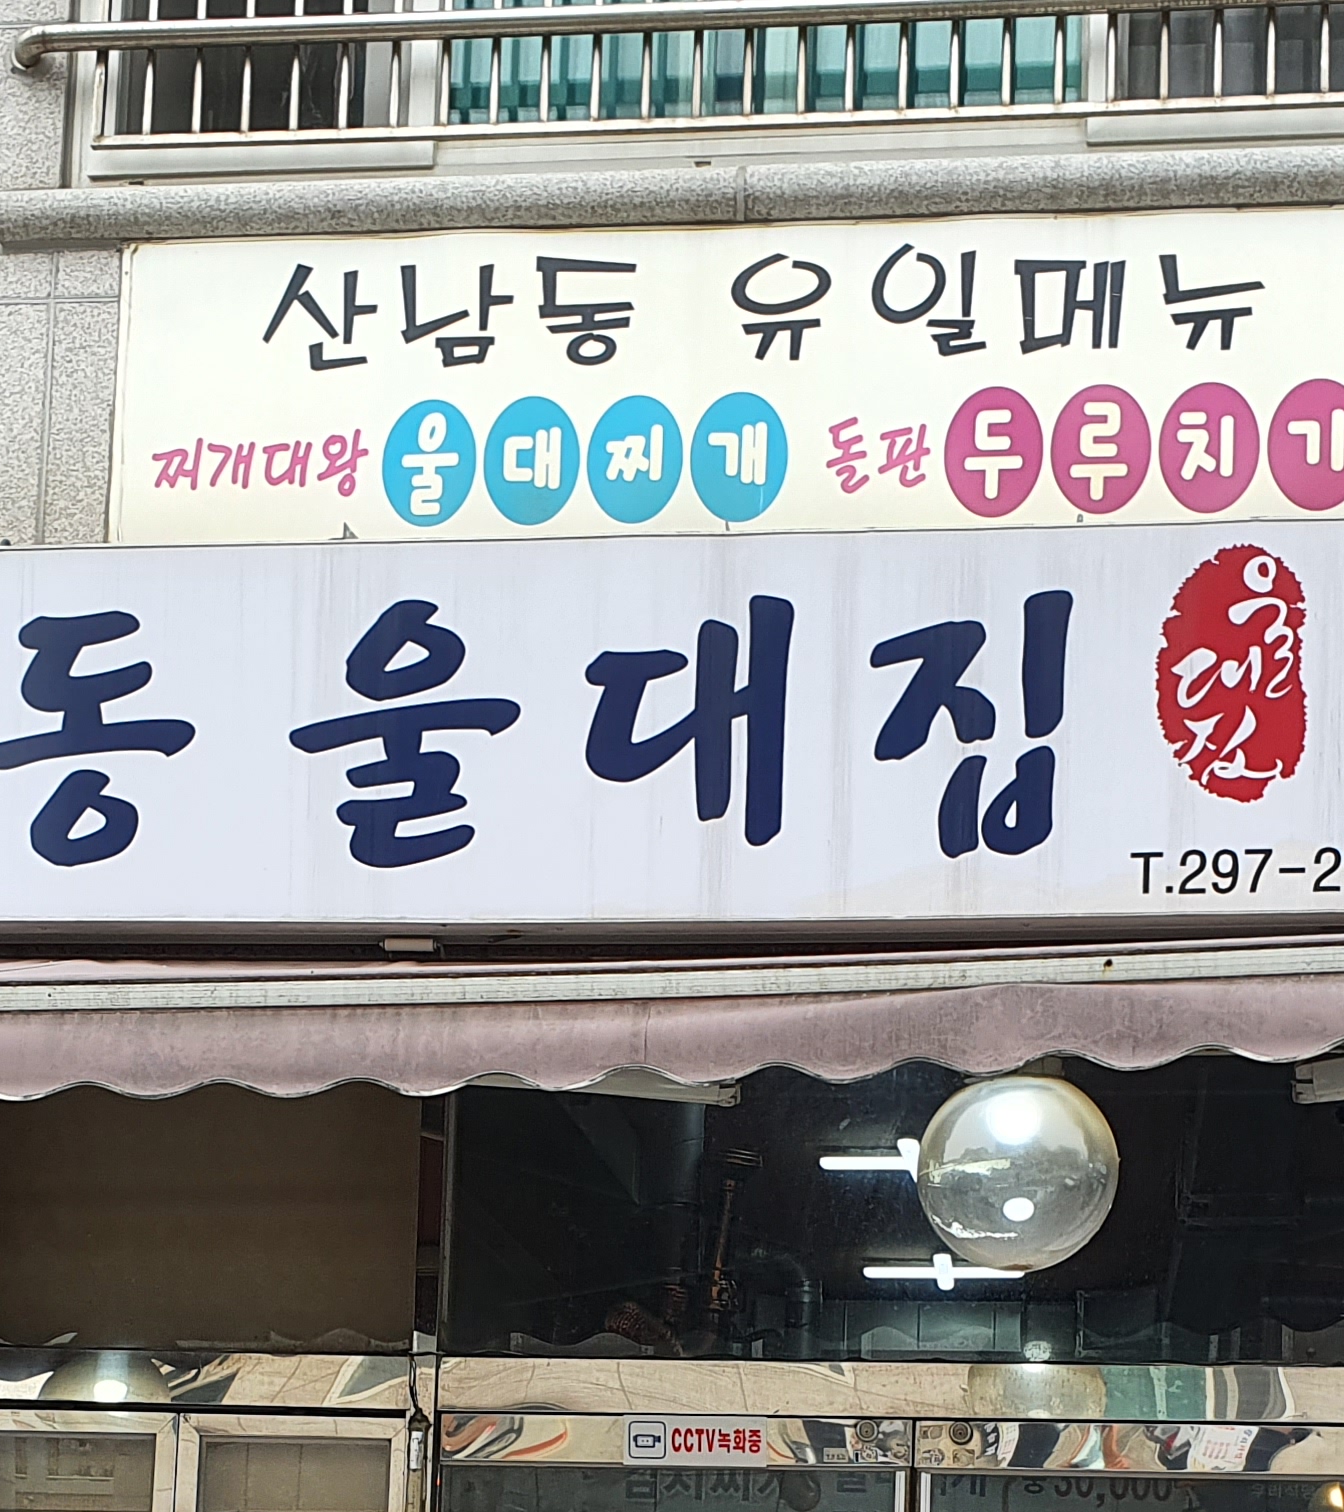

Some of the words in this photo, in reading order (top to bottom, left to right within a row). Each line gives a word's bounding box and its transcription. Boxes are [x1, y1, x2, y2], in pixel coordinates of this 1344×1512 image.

[264, 252, 638, 370] 산남동
[151, 424, 370, 494] 찌개대왕
[399, 416, 773, 518] 울대찌개
[824, 416, 932, 496] 돌판
[288, 589, 1074, 870] 울대집
[670, 1426, 762, 1456] CCTV녹화중
